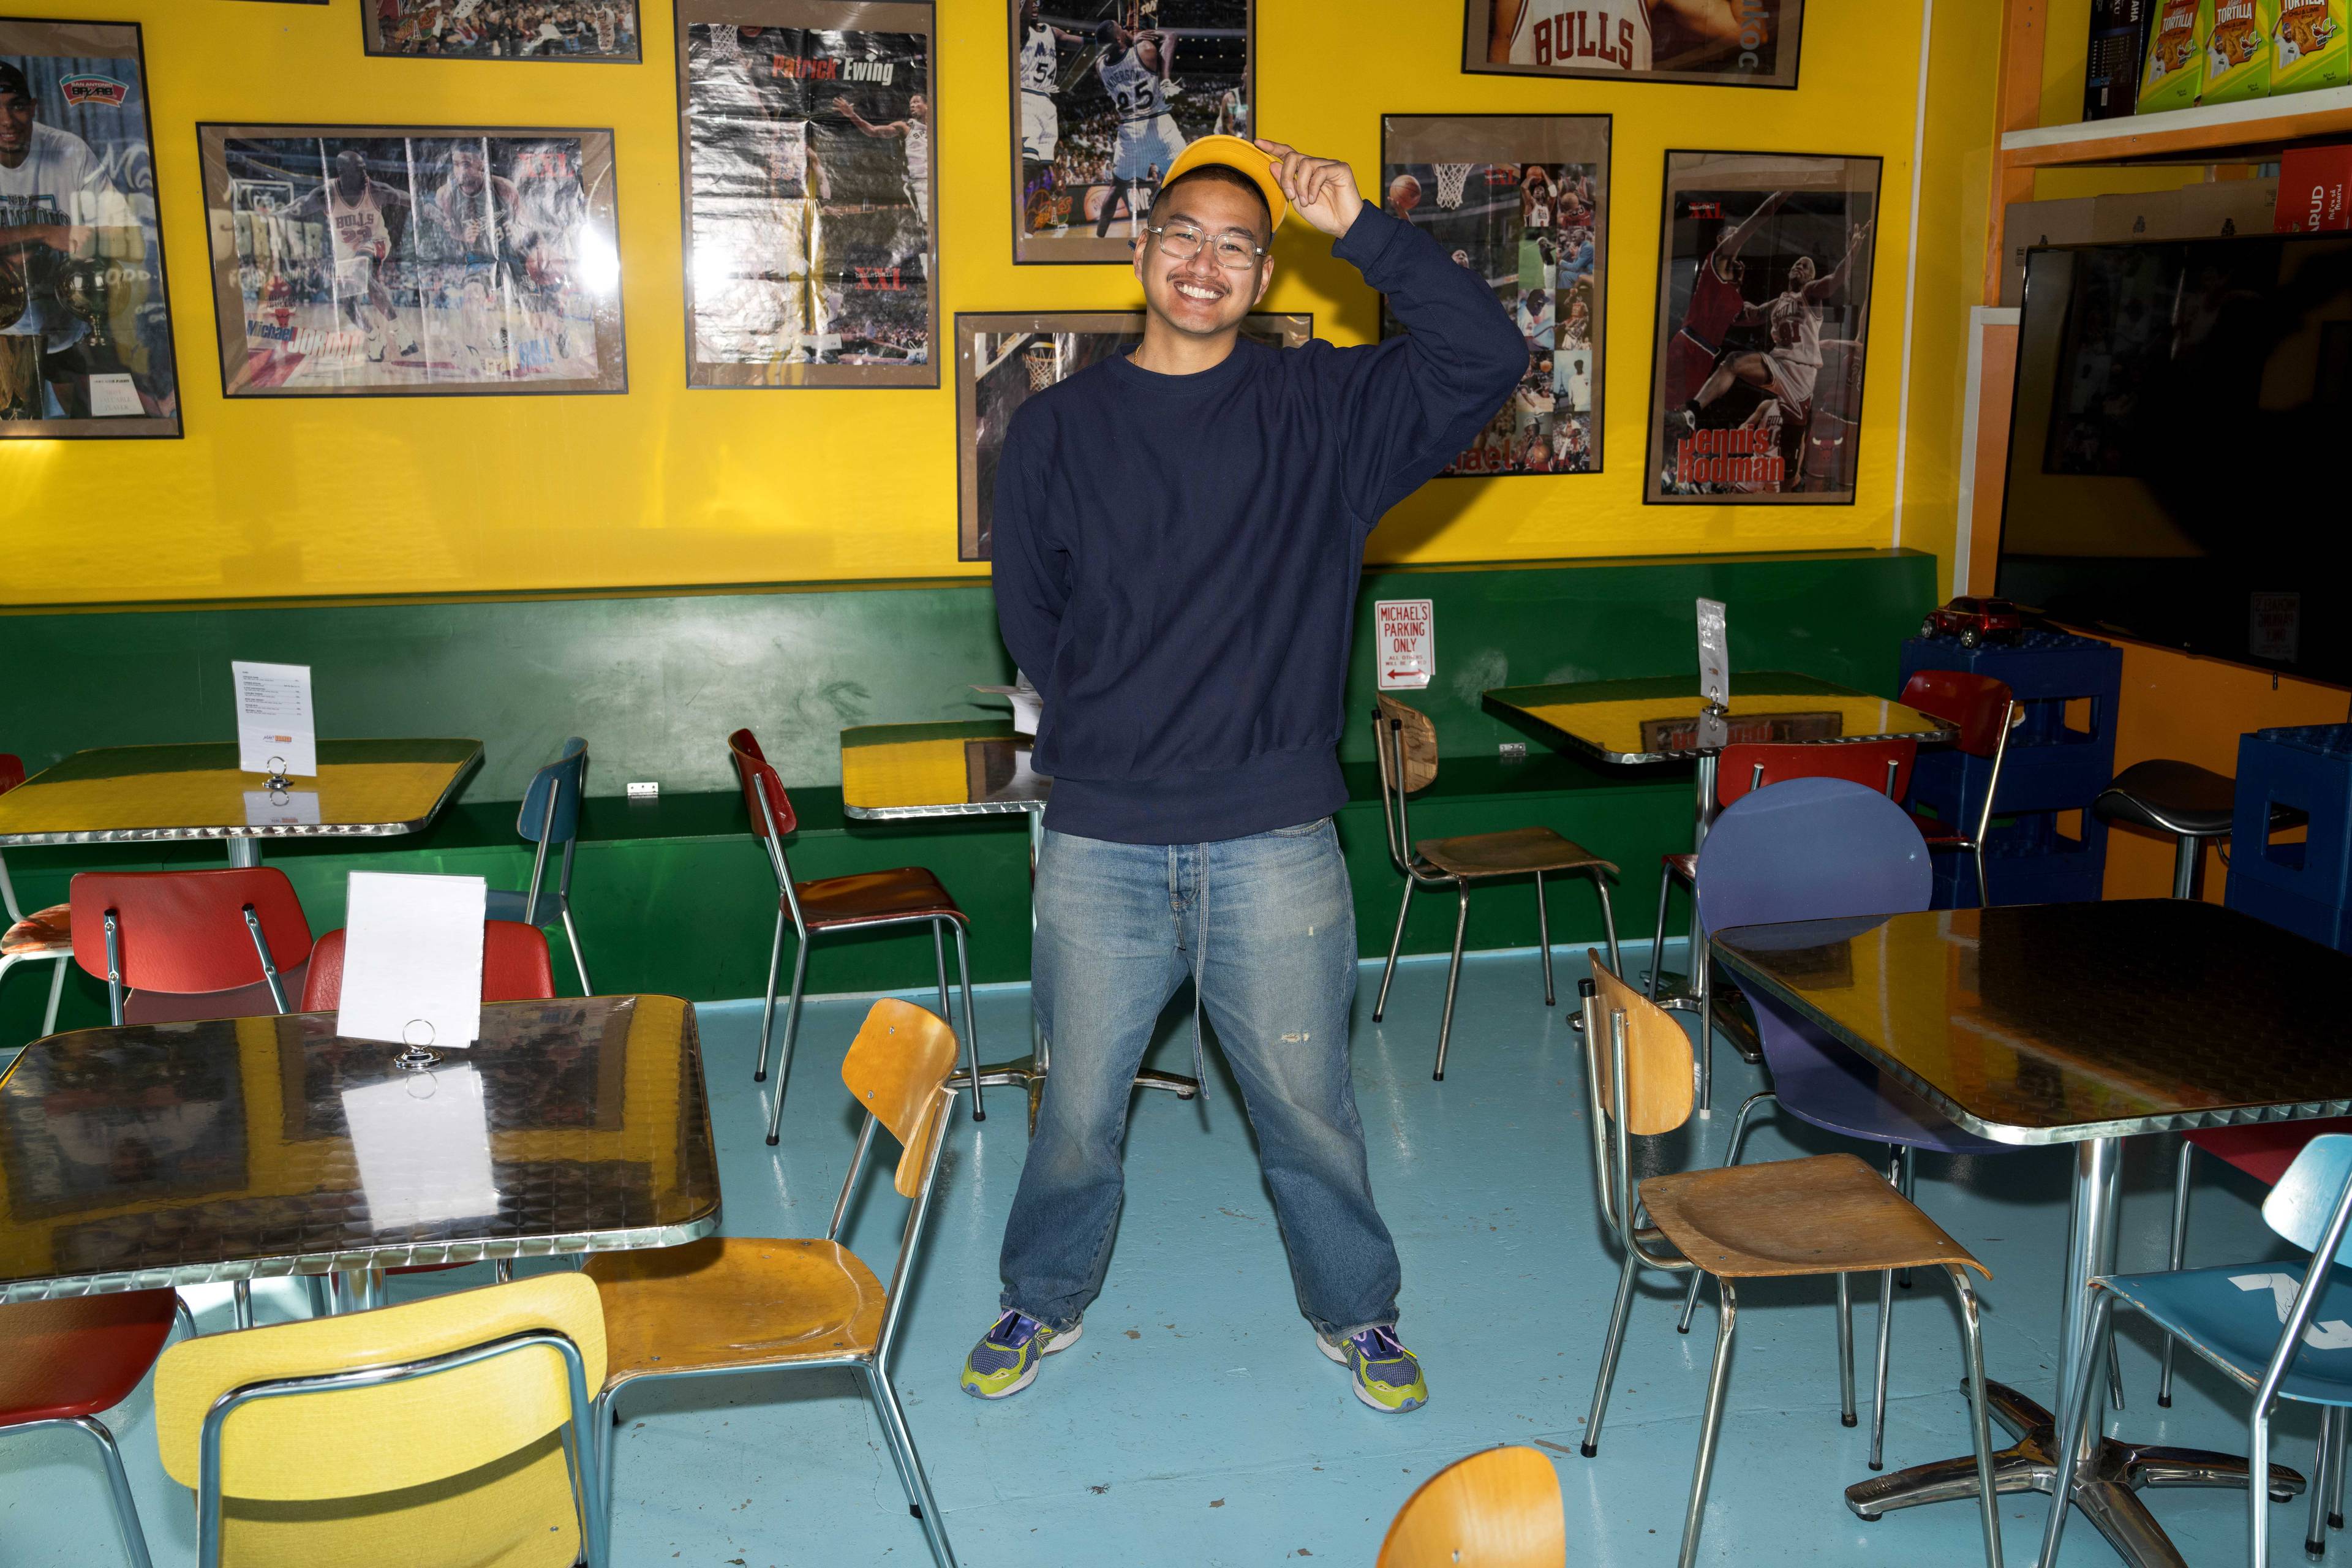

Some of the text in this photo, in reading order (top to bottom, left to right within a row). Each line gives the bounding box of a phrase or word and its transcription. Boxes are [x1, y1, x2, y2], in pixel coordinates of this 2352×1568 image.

[2163, 12, 2193, 32] TORTILLA
[2217, 2, 2253, 23] TORTILLA
[1534, 11, 1634, 70] BULLS
[772, 53, 894, 86] Patrick Ewing
[1033, 62, 1056, 86] 54
[1117, 80, 1153, 113] 25
[1483, 169, 1518, 186] XXL
[335, 211, 374, 228] BULLS
[1689, 202, 1725, 219] XXL
[854, 266, 907, 291] XXL
[247, 320, 295, 342] Michael
[287, 326, 365, 361] JORDAN
[1678, 423, 1770, 454] Dennis
[1677, 452, 1785, 483] Rodman
[1381, 603, 1428, 622] MICHAEL'S
[1385, 622, 1425, 638] PARKING
[1393, 638, 1417, 653] ONLY
